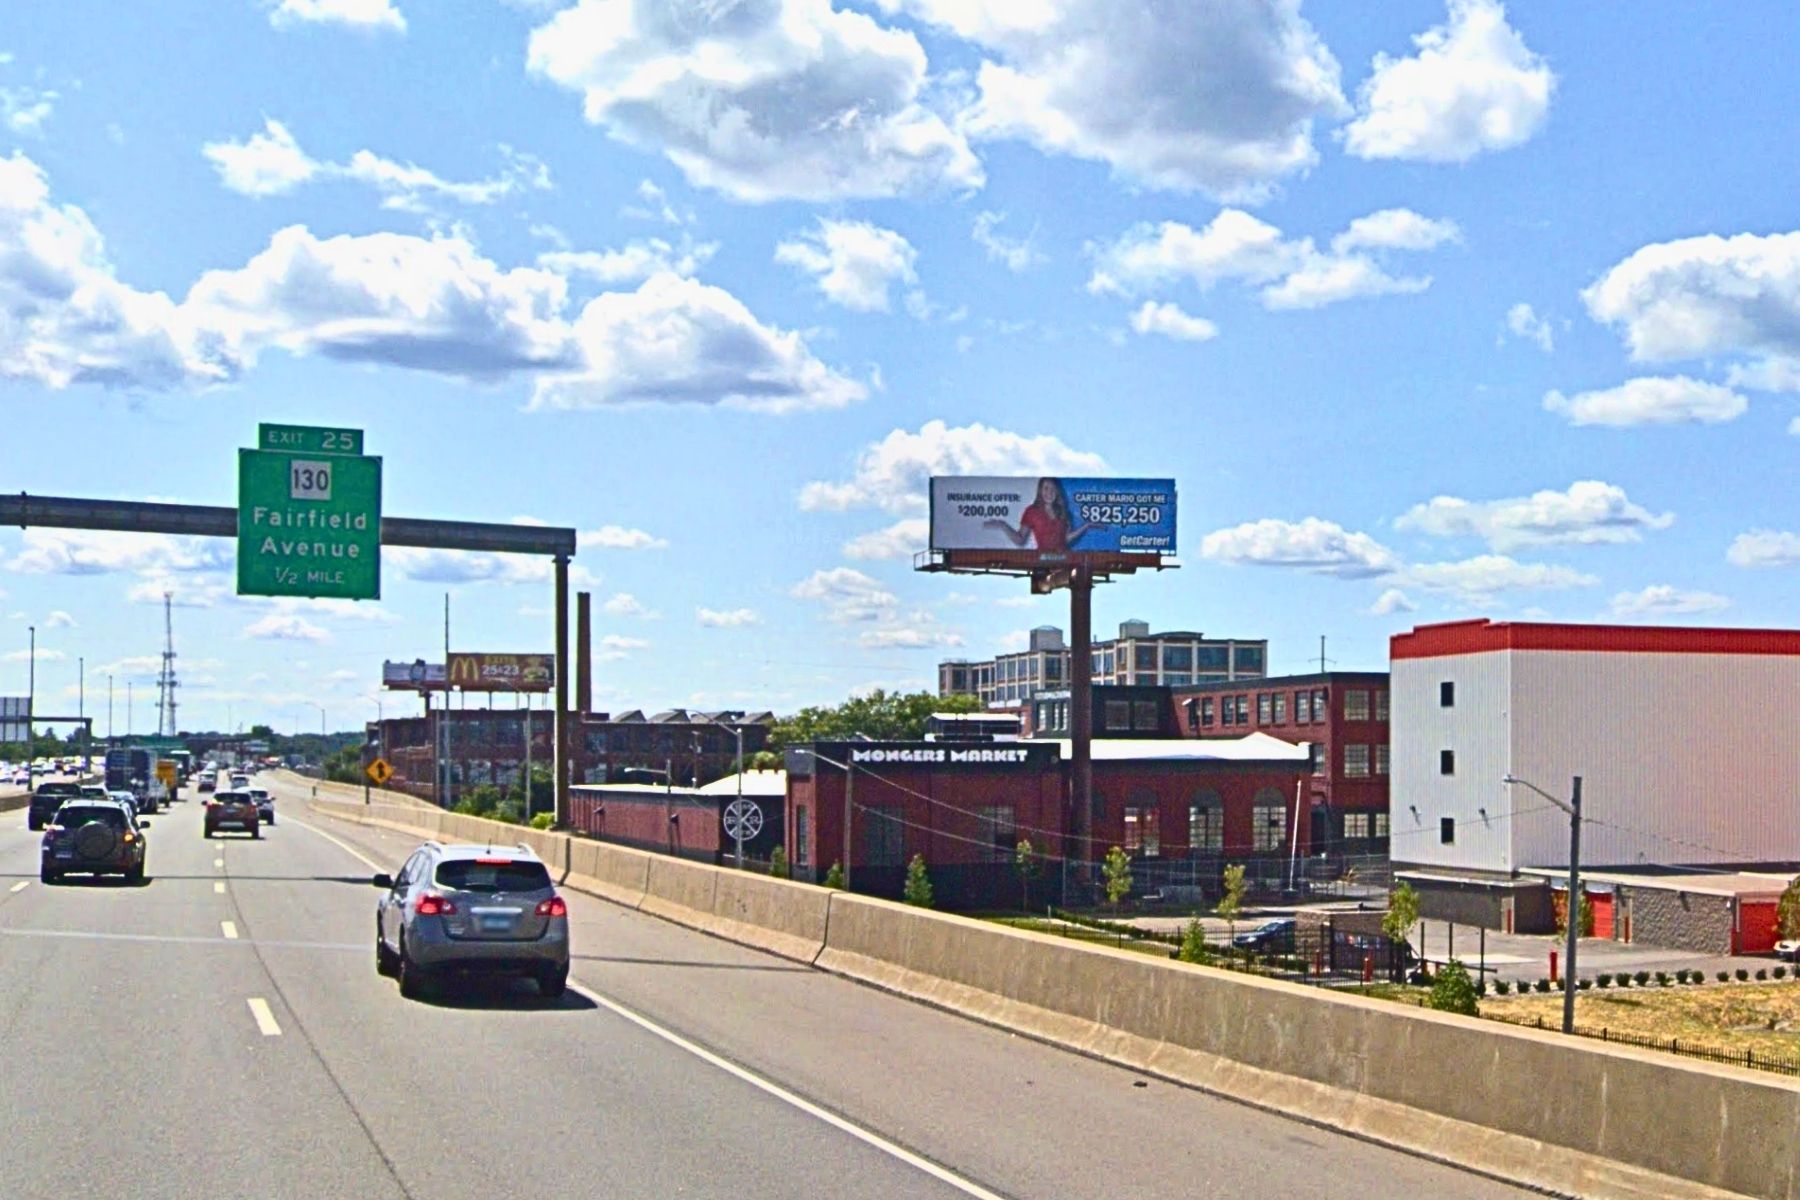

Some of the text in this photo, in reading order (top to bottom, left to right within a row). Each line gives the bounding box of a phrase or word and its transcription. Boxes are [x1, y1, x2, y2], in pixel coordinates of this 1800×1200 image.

[268, 431, 354, 450] EXIT 25
[294, 468, 330, 491] 130
[947, 493, 1021, 502] INSURANCE OFFER:
[1075, 493, 1166, 504] CARTER MARIO GOT ME
[958, 504, 1009, 518] $200,000
[1082, 505, 1160, 526] $825,250
[253, 507, 367, 530] Fairfield
[261, 536, 360, 558] Avenue
[1120, 535, 1170, 547] GetCarter!
[307, 571, 344, 584] MILE
[852, 749, 1028, 762] MONGERS MARKET
